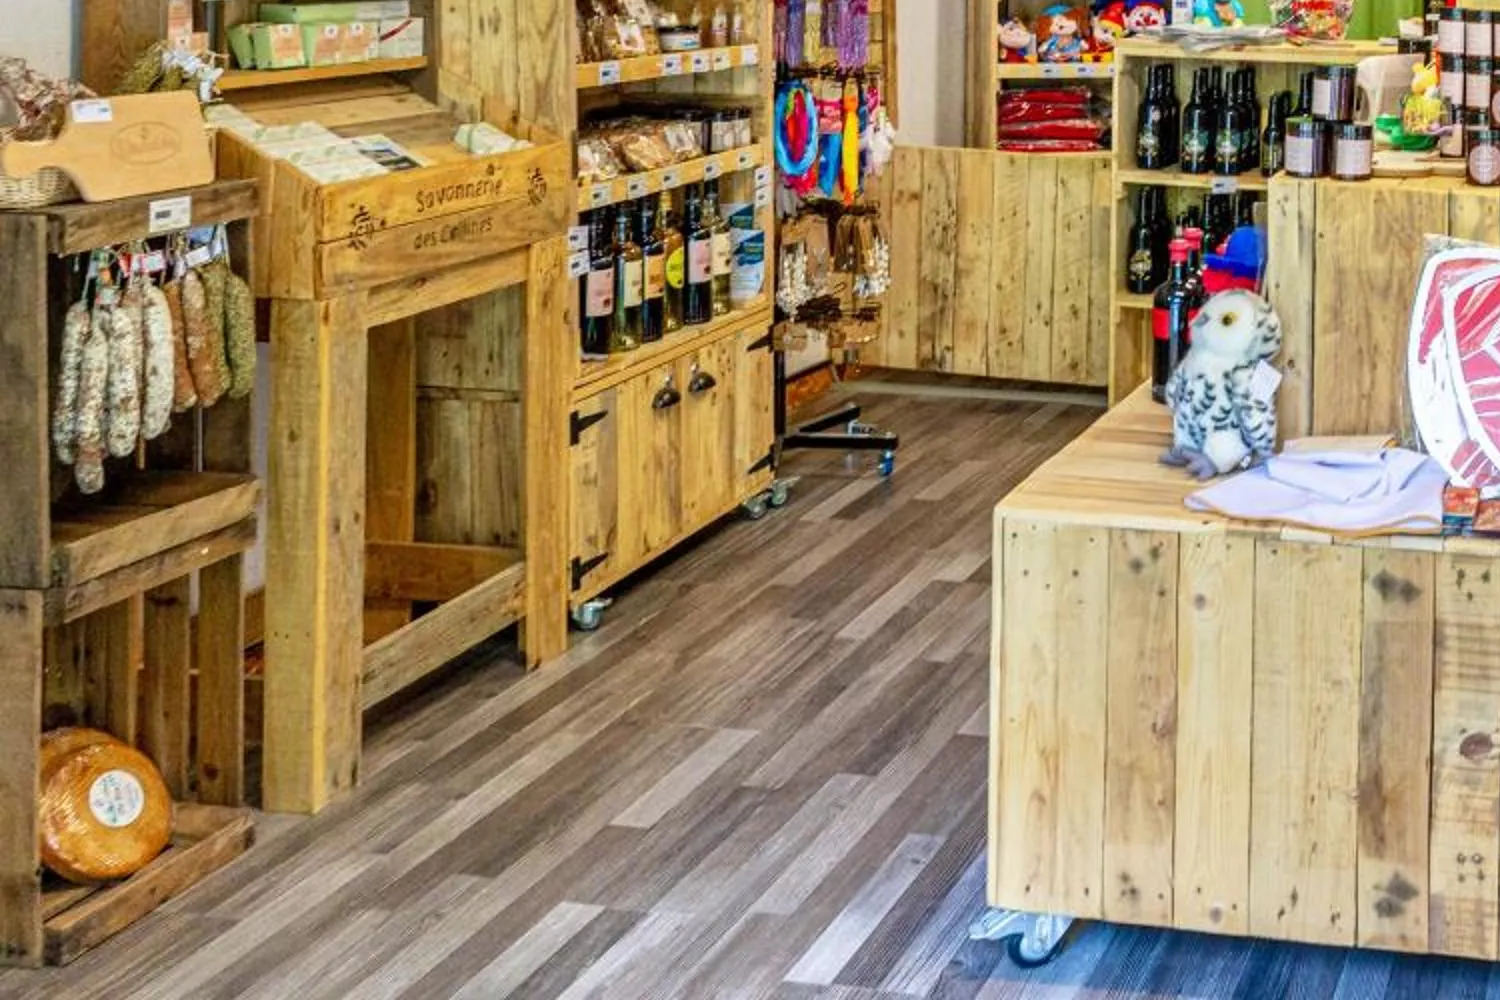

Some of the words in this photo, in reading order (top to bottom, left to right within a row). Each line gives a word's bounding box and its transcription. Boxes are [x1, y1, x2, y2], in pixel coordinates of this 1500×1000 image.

[416, 180, 502, 213] Savonnerie
[414, 231, 437, 250] des
[440, 217, 493, 244] Collines
